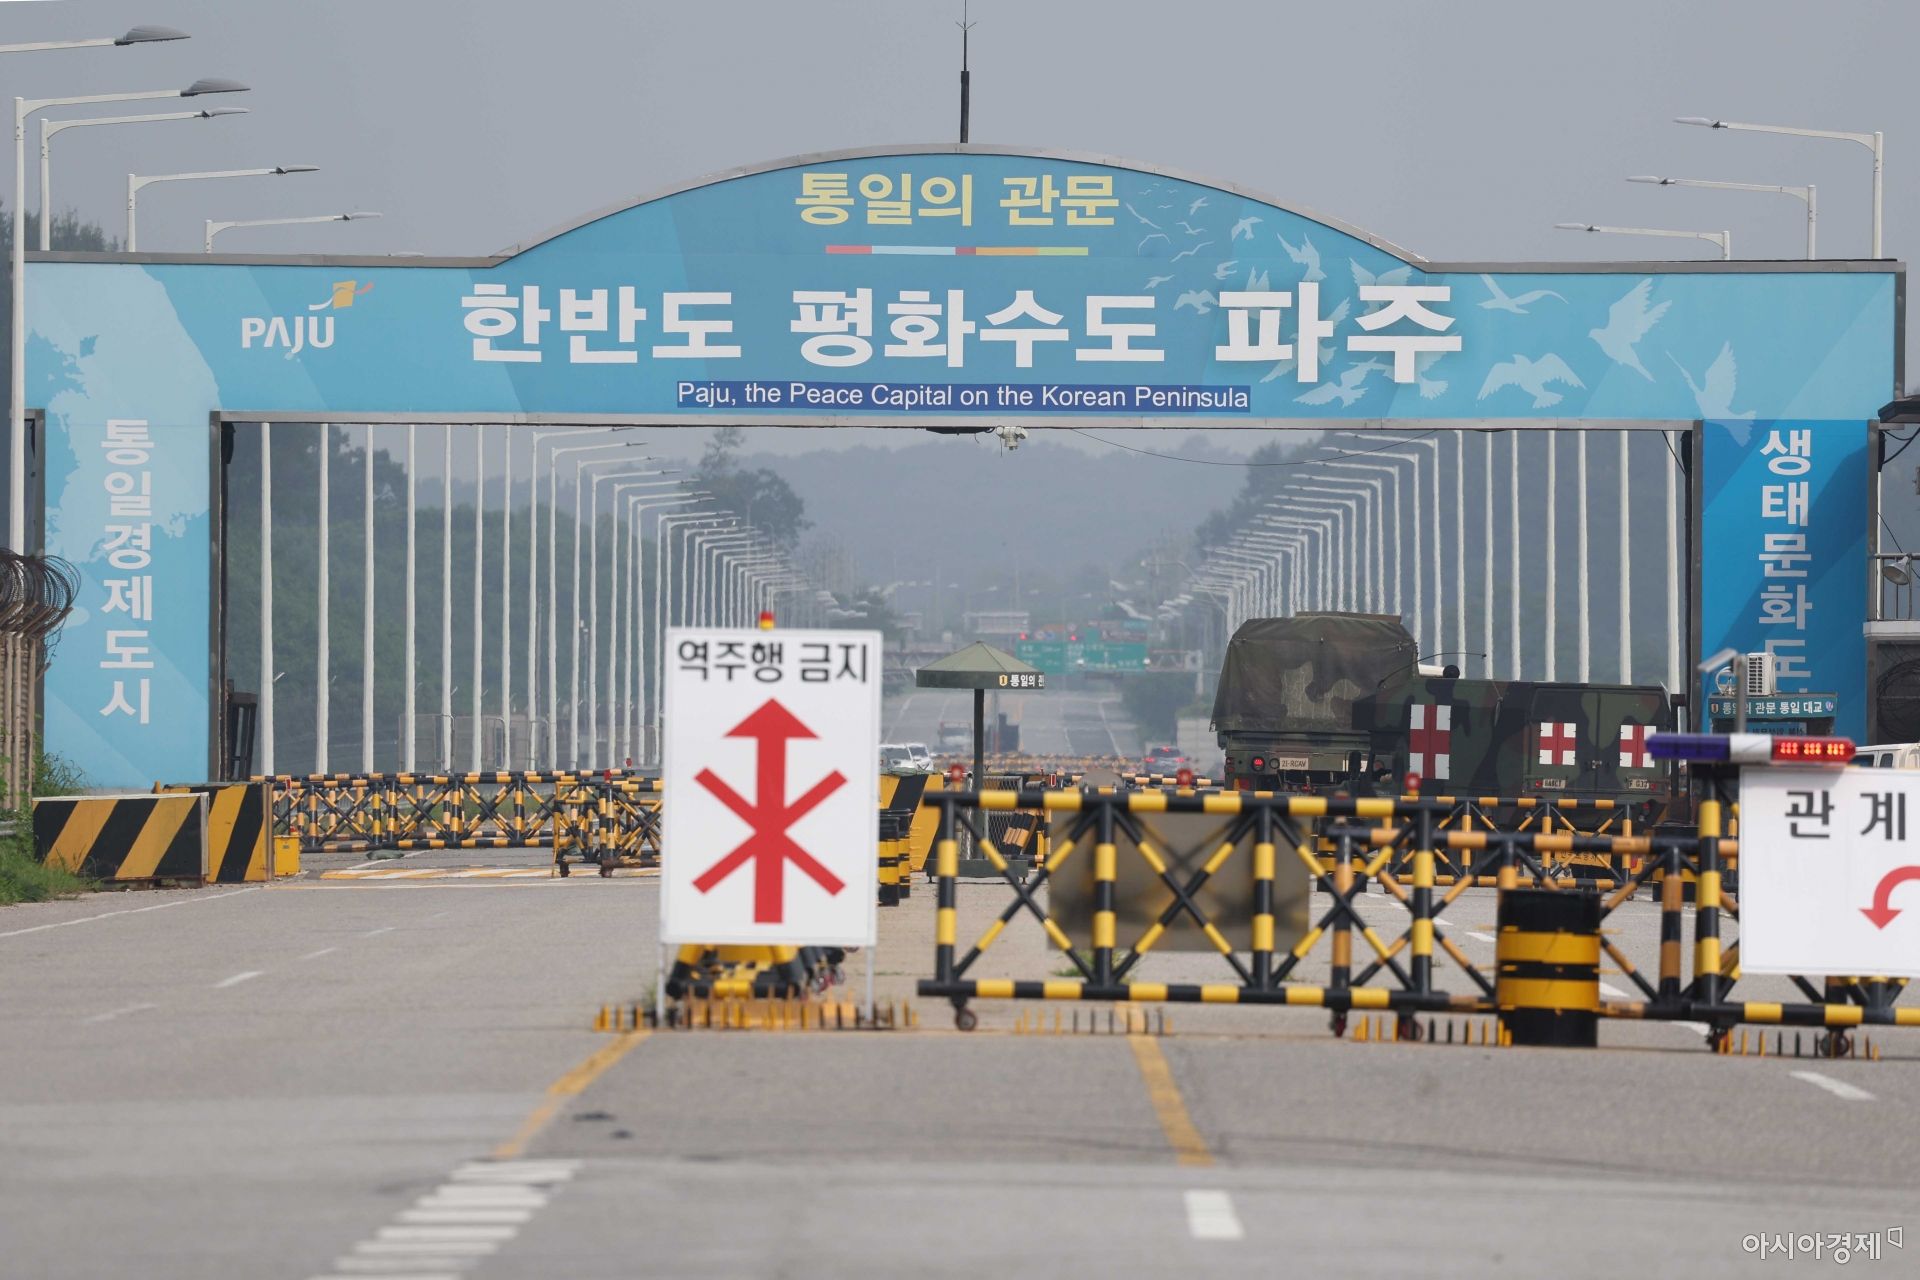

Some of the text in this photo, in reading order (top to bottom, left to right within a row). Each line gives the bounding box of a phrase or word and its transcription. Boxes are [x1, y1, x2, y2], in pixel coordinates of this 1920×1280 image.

[795, 173, 1120, 226] 통일의 관문
[242, 316, 335, 354] PAJU
[462, 282, 1463, 384] 한반도 평화수도 파주
[678, 383, 1248, 410] Paju, the Peace Capital on the Korean Peninsula
[100, 419, 155, 724] 통일경제도시
[1758, 429, 1814, 692] 생태문화도
[678, 640, 867, 684] 역주행 금지
[1009, 674, 1036, 687] 통일의
[1755, 702, 1776, 715] 관문
[1779, 702, 1800, 715] 통일
[1803, 701, 1823, 714] 대교
